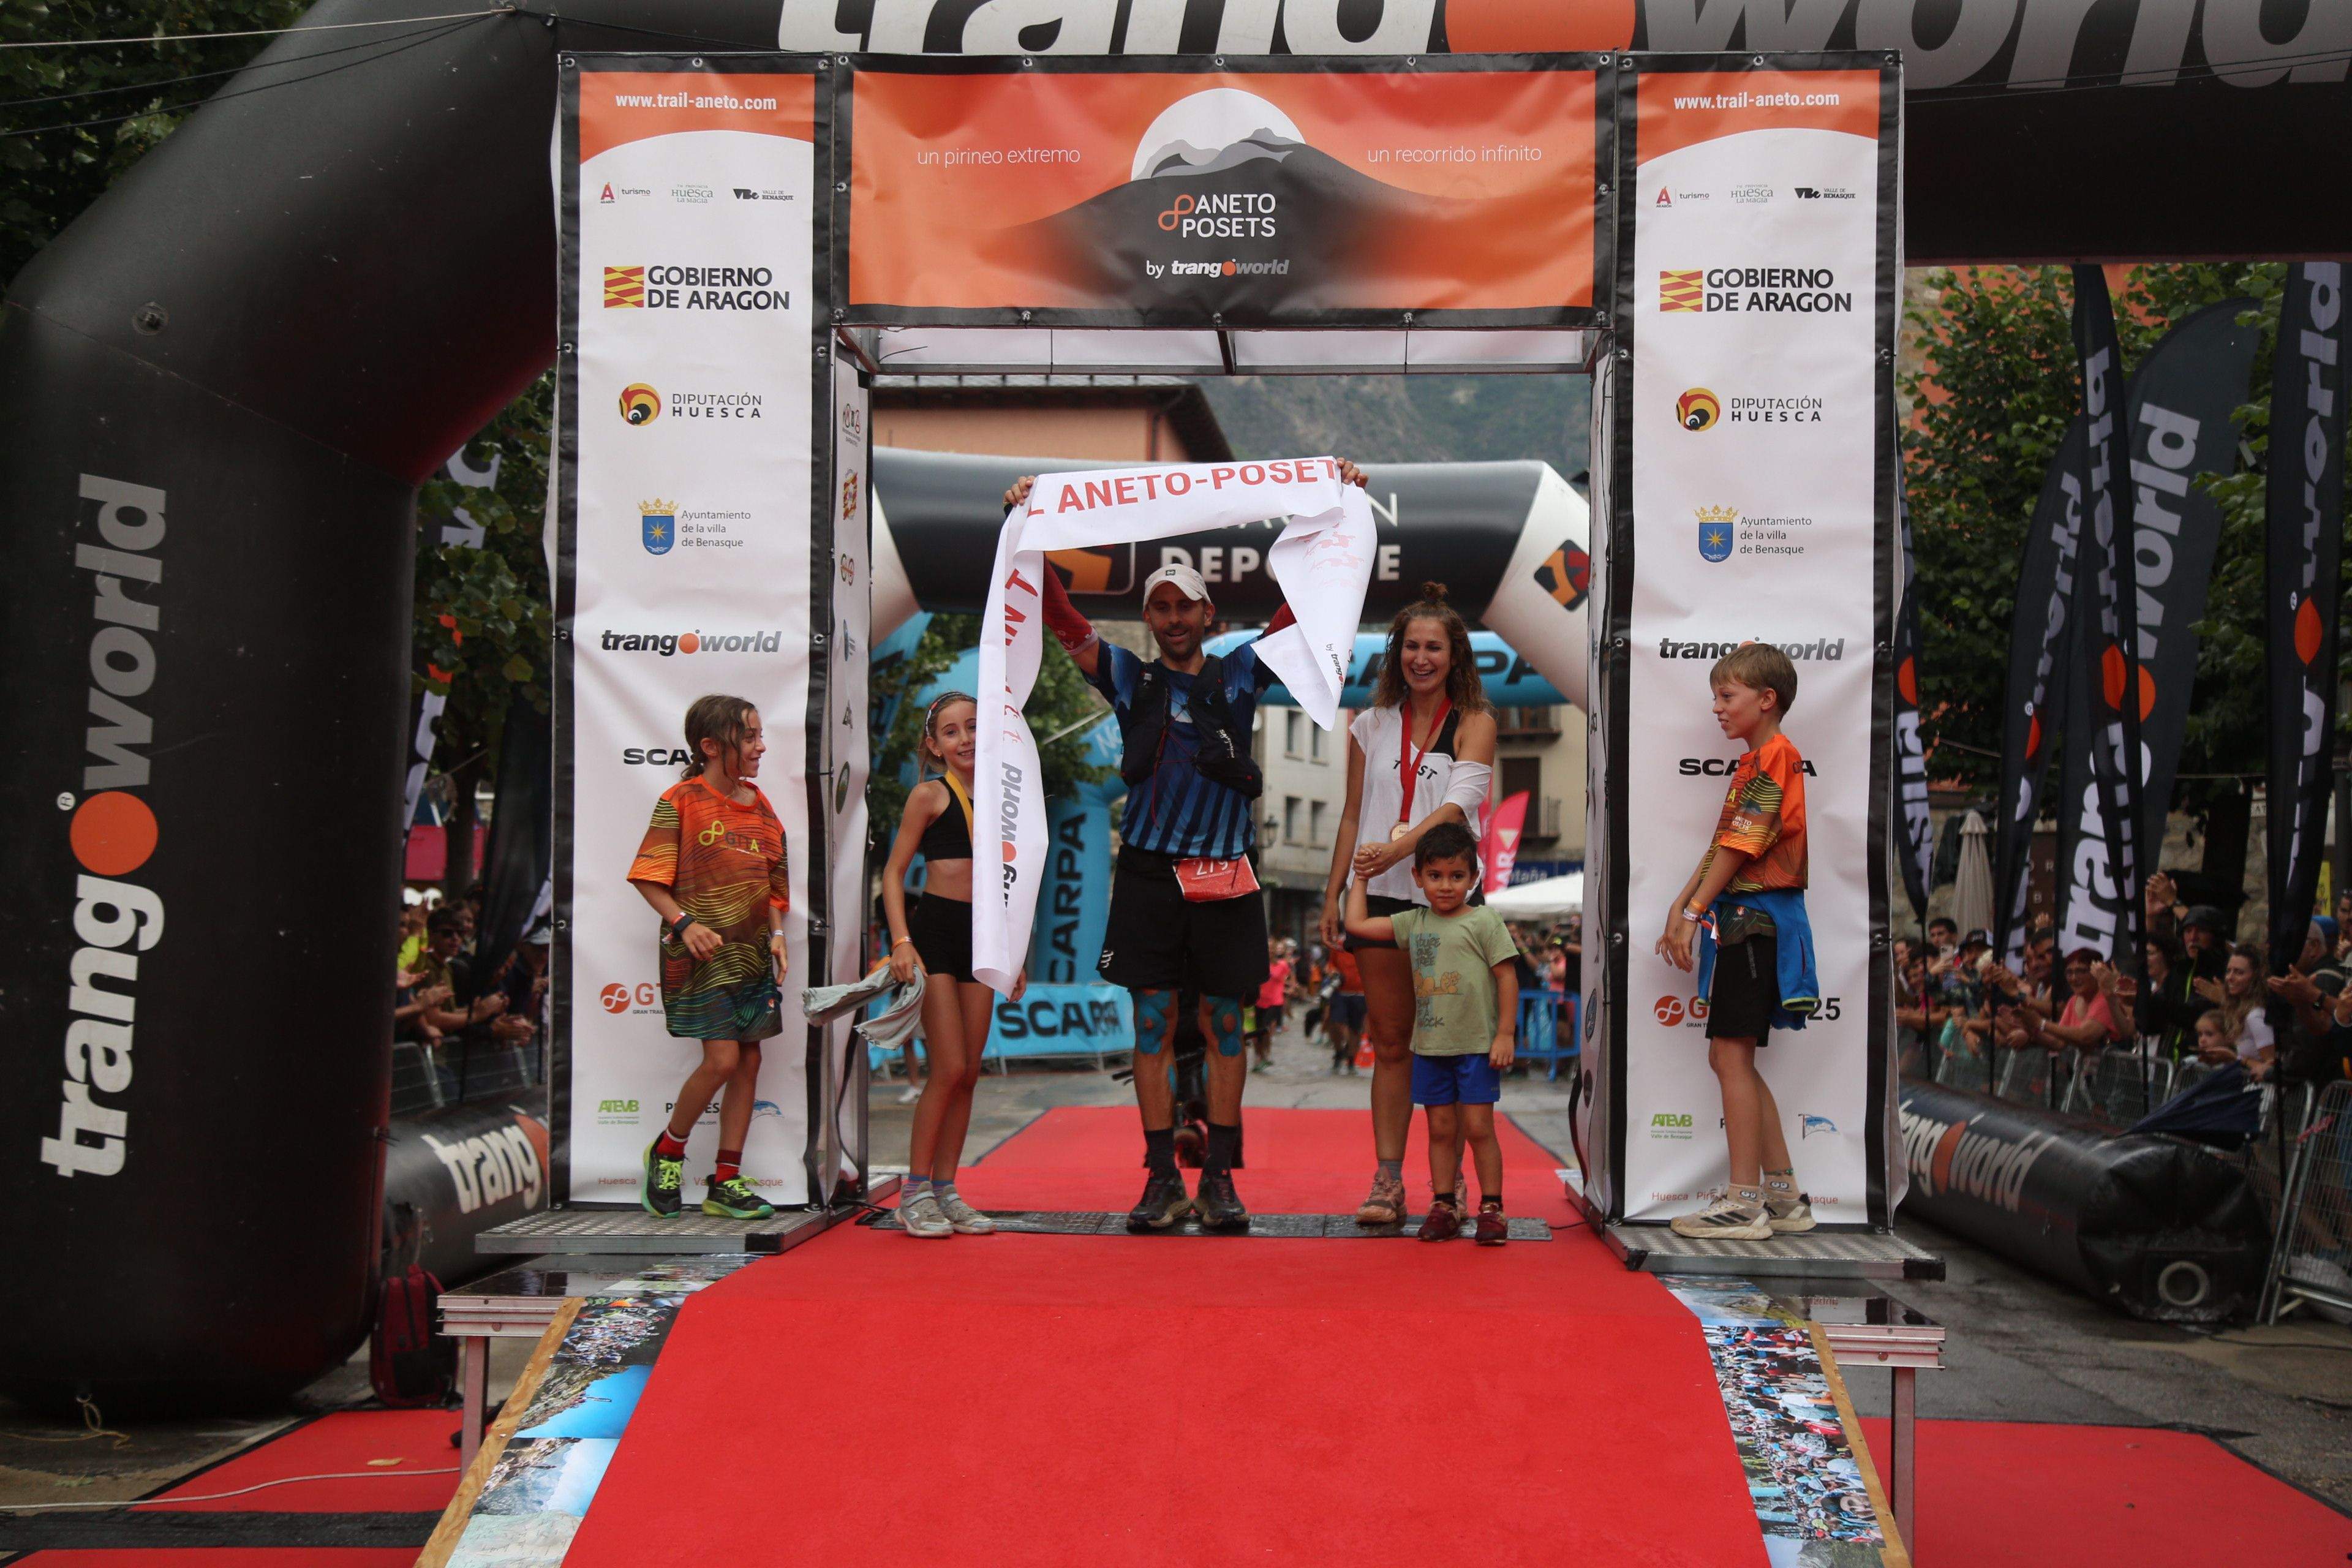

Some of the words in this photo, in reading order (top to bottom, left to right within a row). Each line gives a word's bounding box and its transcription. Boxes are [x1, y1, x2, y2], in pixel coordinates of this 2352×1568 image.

[615, 92, 777, 111] www.trail-aneto.com
[1673, 91, 1840, 110] www.trail-aneto.com
[918, 151, 939, 165] un
[944, 148, 1003, 168] pirineo
[1007, 147, 1080, 164] extremo
[1368, 148, 1389, 162] un
[1395, 145, 1476, 162] recorrido
[1482, 145, 1542, 162] infinito
[1194, 193, 1276, 214] ANETO
[1182, 217, 1276, 238] POSETS
[648, 265, 773, 287] GOBIERNO
[1146, 260, 1165, 279] by
[1706, 268, 1834, 289] GOBIERNO
[647, 290, 679, 309] DE
[685, 290, 790, 311] ARAGON
[1706, 293, 1738, 312] DE
[1746, 293, 1852, 312] ARAGON
[672, 392, 762, 406] DIPUTACIÓN
[1732, 395, 1823, 409] DIPUTACIÓN
[672, 407, 761, 419] HUESCA
[1732, 411, 1822, 422] HUESCA
[1057, 458, 1336, 514] ANETO-POSET
[681, 510, 752, 522] Ayuntamiento
[1740, 516, 1812, 528] Ayuntamiento
[681, 524, 694, 534] de
[696, 524, 705, 534] la
[706, 524, 727, 534] villa
[1740, 530, 1753, 540] de
[1755, 530, 1764, 540] la
[1766, 530, 1787, 540] villa
[681, 538, 694, 548] de
[696, 538, 744, 550] Benasque
[1740, 545, 1753, 554] de
[1755, 545, 1804, 556] Benasque
[1651, 1191, 1689, 1201] Huesca
